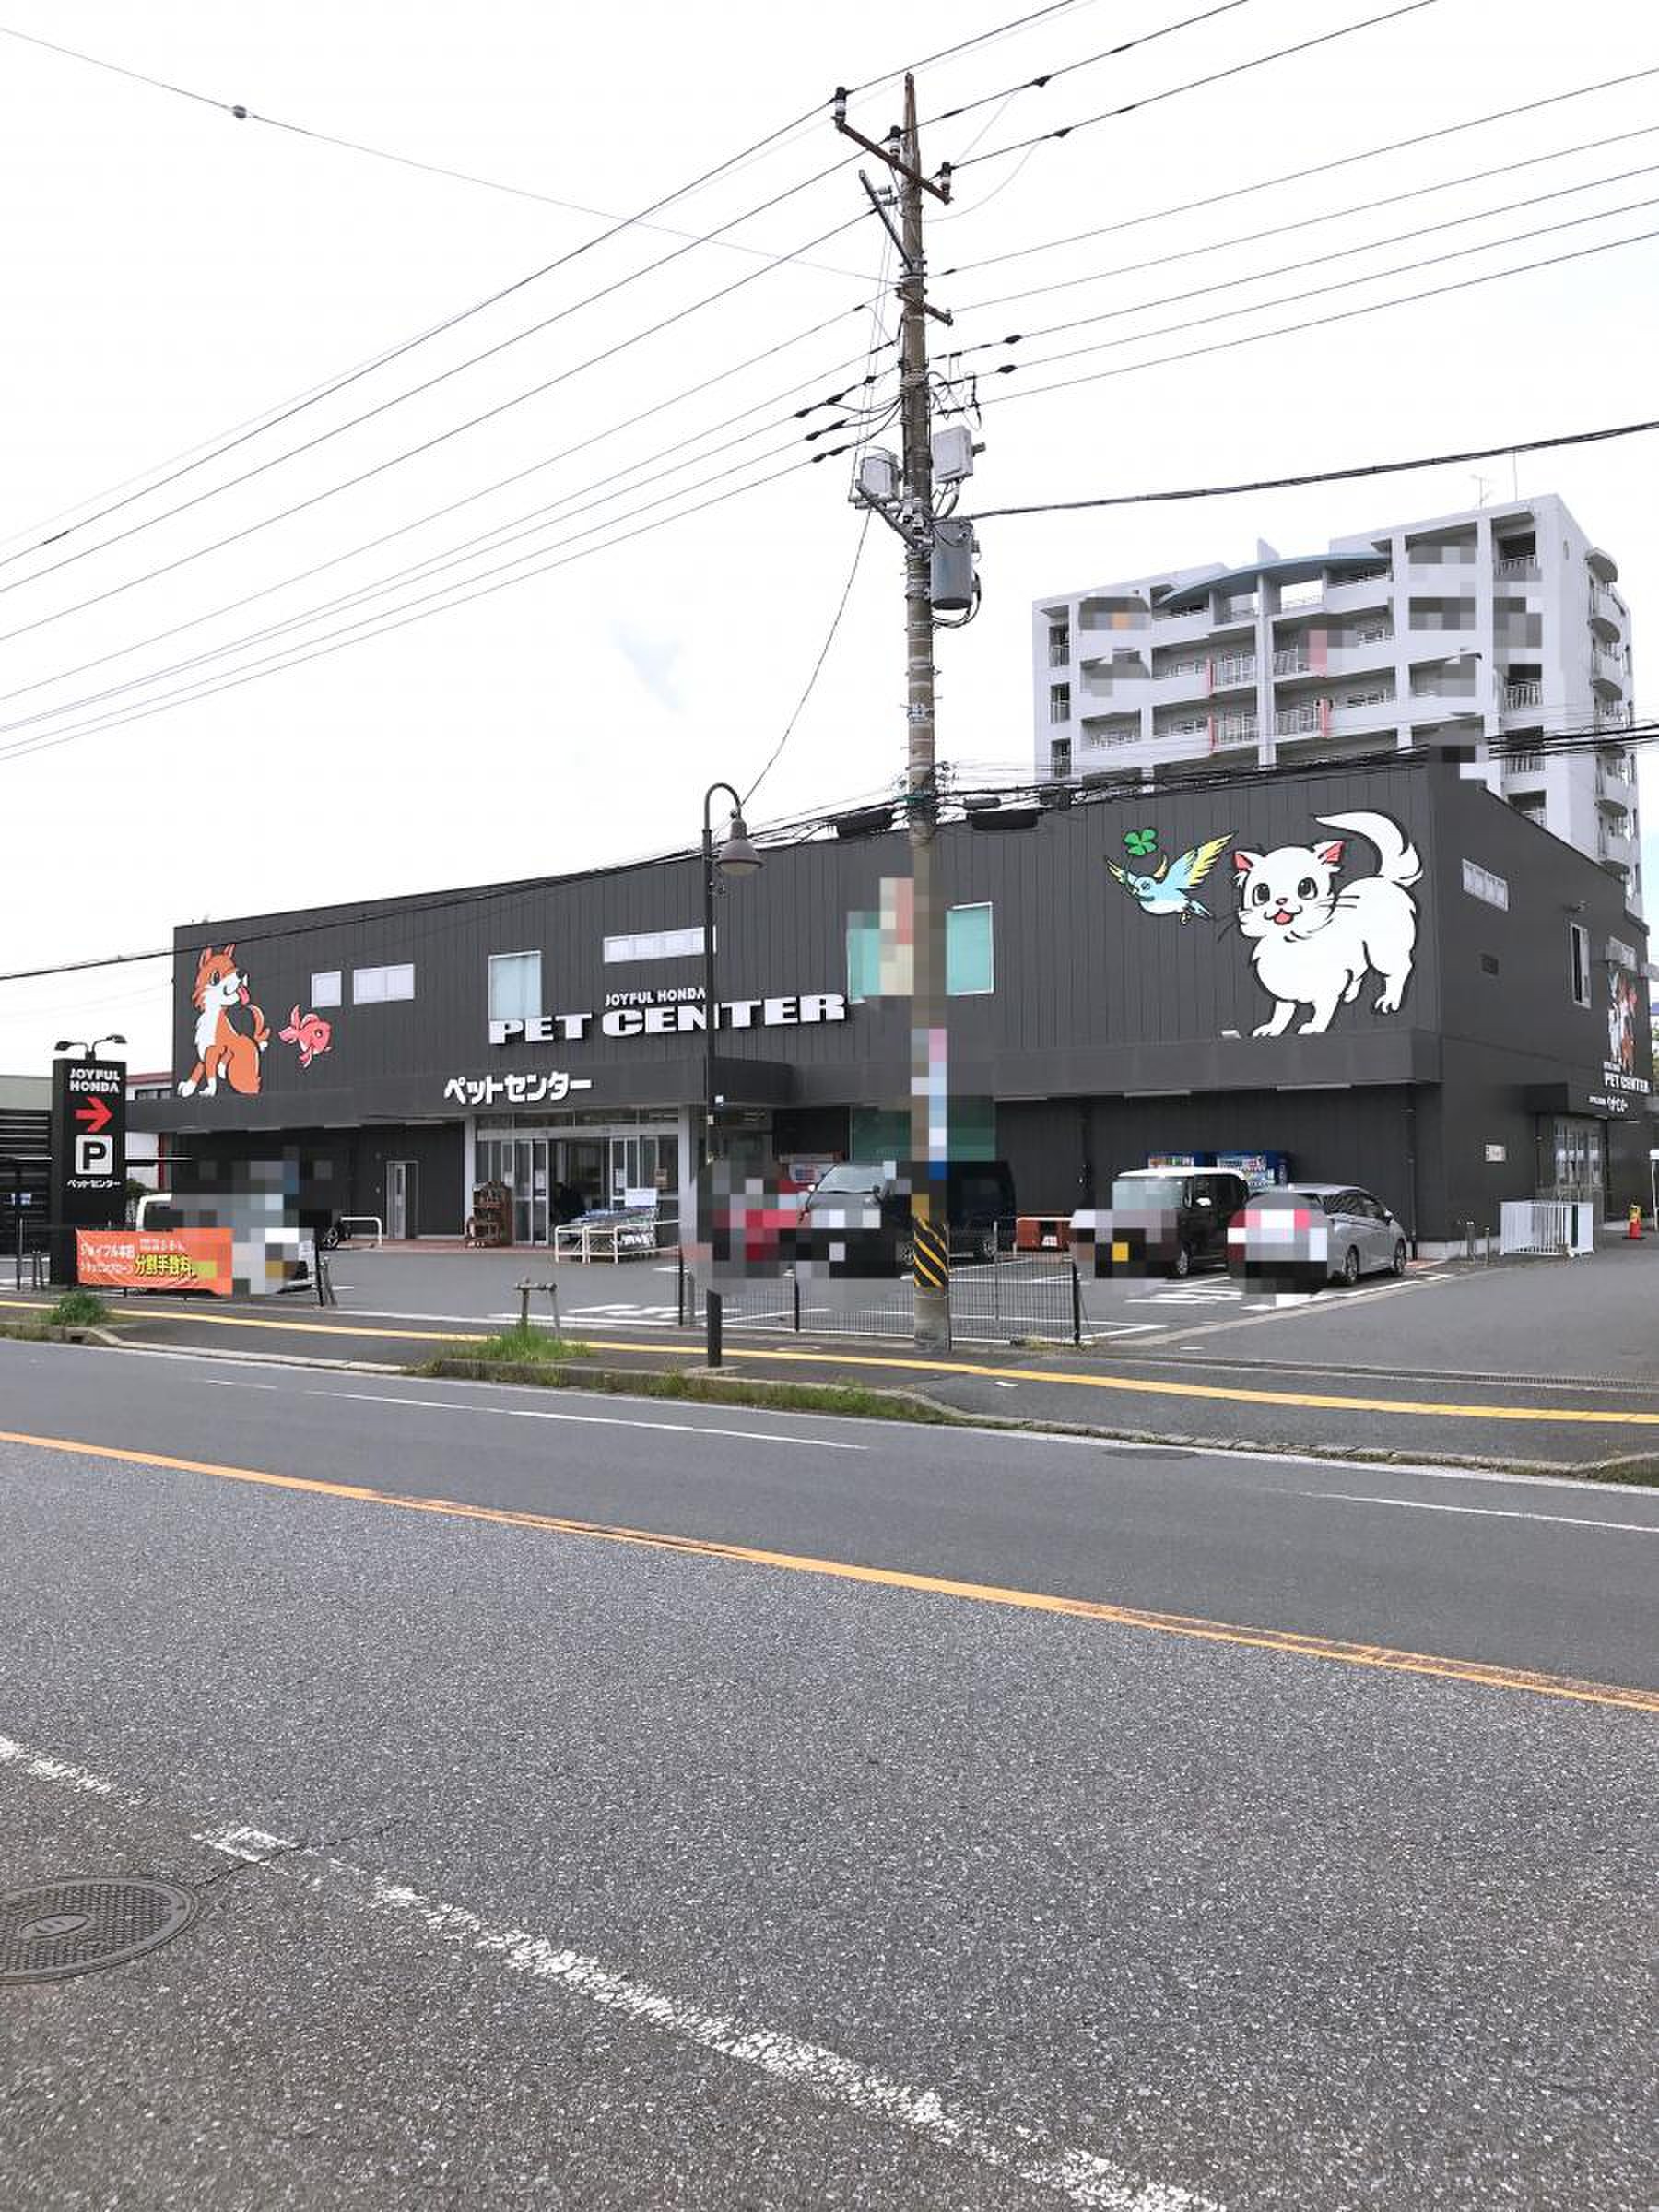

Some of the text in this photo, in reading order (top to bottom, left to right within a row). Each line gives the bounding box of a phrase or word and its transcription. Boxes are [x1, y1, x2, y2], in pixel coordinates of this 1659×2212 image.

[605, 987, 706, 1007] JOYFUL HONDA
[488, 994, 845, 1044] PET CENTER
[69, 1068, 121, 1081] JOYFUL
[69, 1080, 119, 1093] HONDA
[443, 1070, 592, 1105] ペットセンター
[83, 1141, 107, 1171] P
[67, 1179, 121, 1189] ペットセンター
